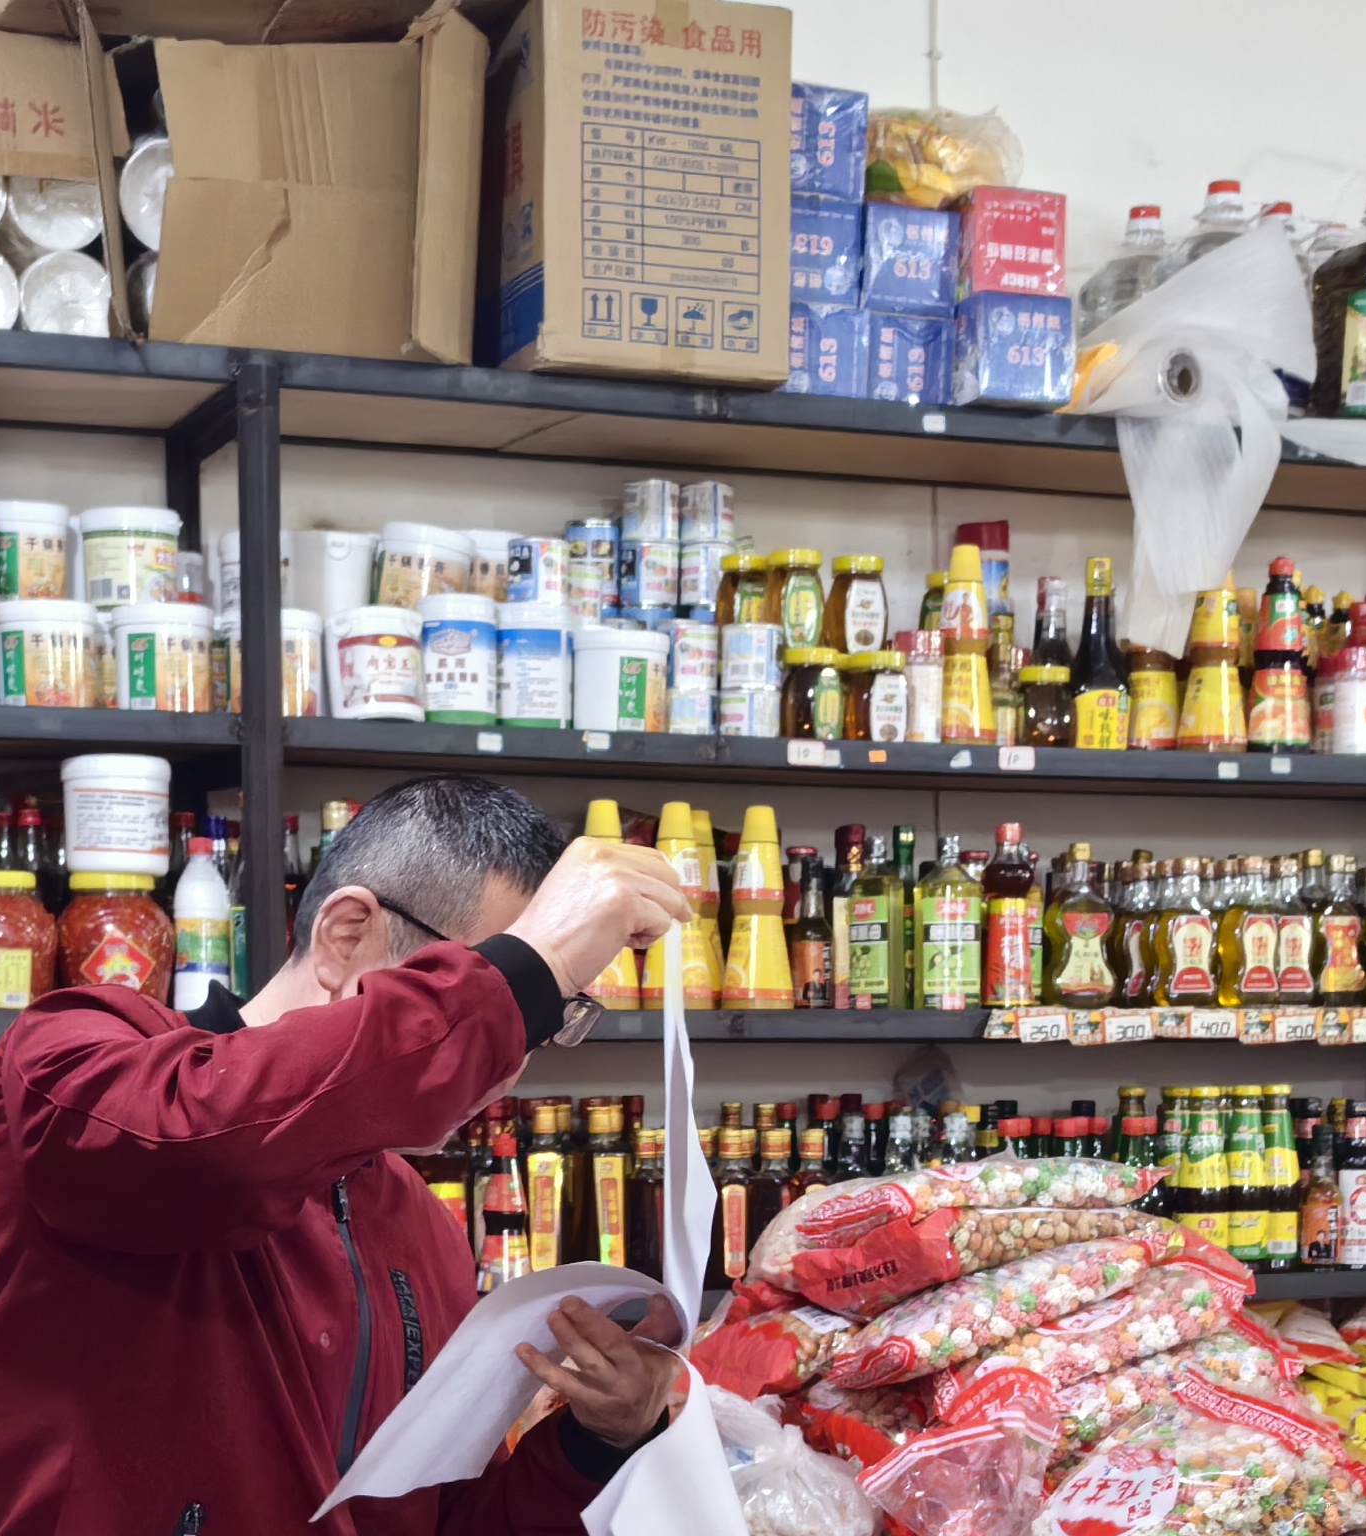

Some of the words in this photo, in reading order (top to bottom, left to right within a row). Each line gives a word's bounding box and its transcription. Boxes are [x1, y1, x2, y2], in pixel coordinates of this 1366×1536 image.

[581, 8, 666, 46] 防污染
[682, 20, 763, 59] 食品用
[893, 257, 932, 281] 613
[1006, 344, 1046, 367] 613
